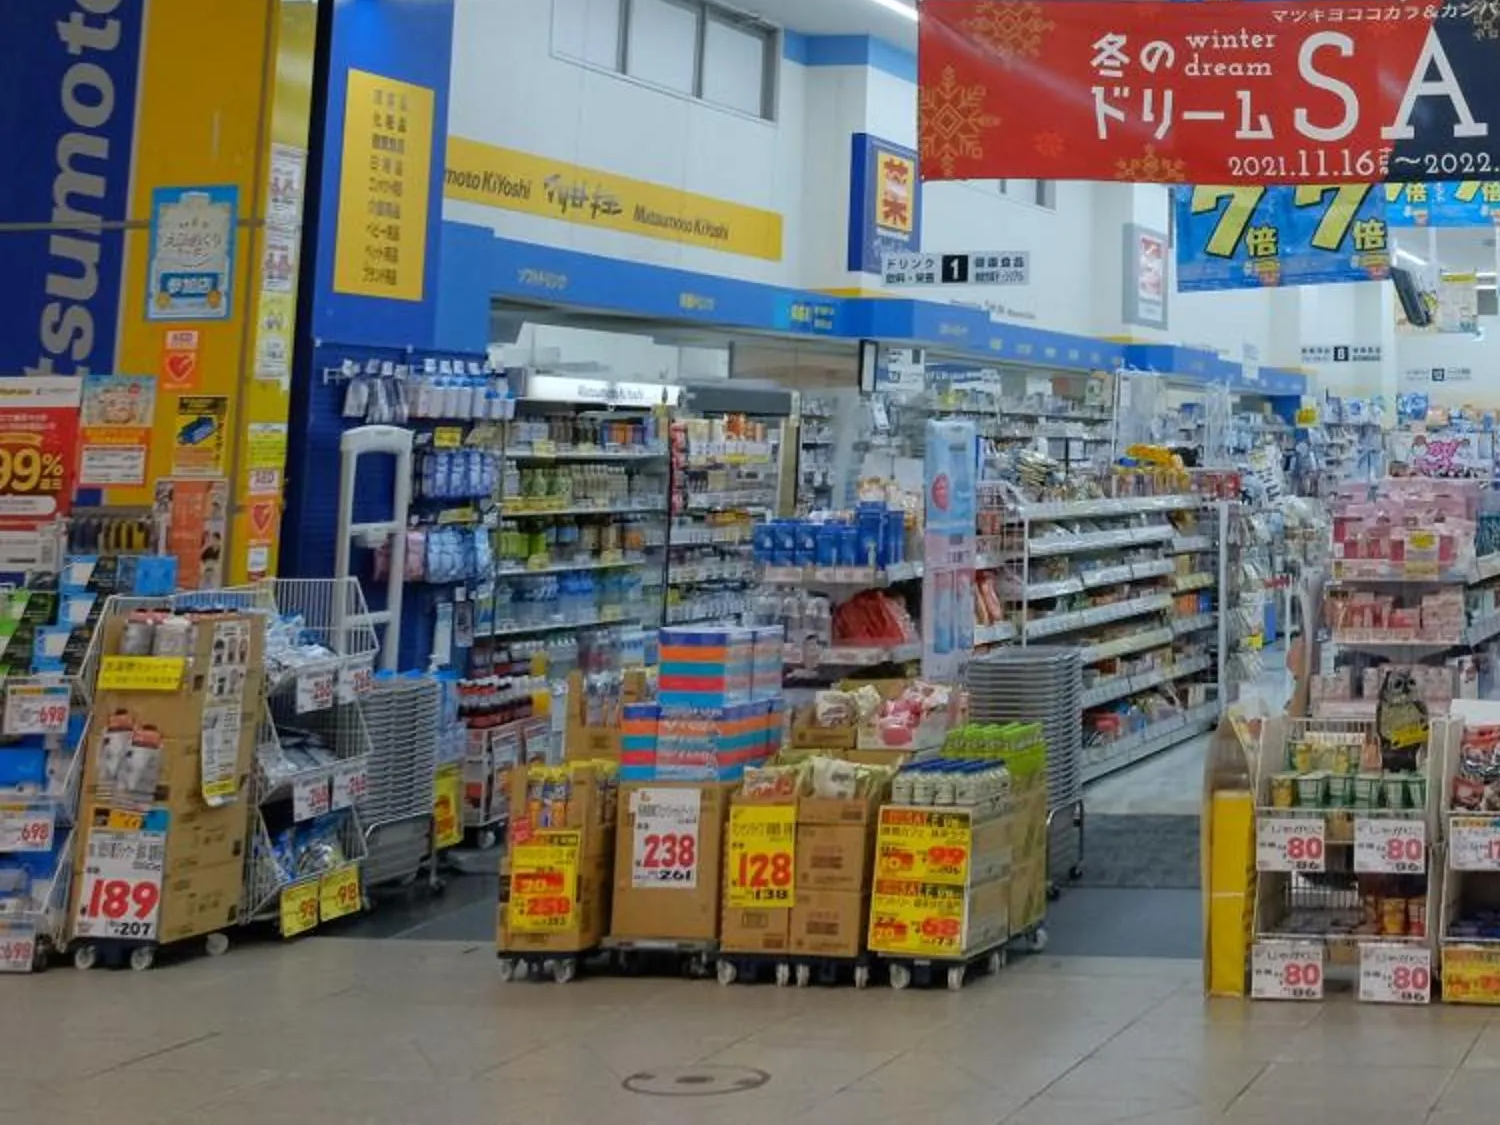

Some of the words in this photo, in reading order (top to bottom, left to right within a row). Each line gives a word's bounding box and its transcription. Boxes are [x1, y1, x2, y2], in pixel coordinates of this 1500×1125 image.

[1185, 31, 1277, 50] winter
[1089, 31, 1175, 78] 冬の
[1185, 57, 1273, 77] dream
[1090, 86, 1275, 141] ドリーム
[643, 832, 695, 868] 238
[1286, 837, 1323, 860] 80
[1386, 838, 1423, 860] 80
[738, 852, 792, 888] 128
[88, 878, 160, 920] 189
[119, 921, 152, 936] 207
[1283, 962, 1321, 986] 80
[1393, 965, 1430, 989] 80
